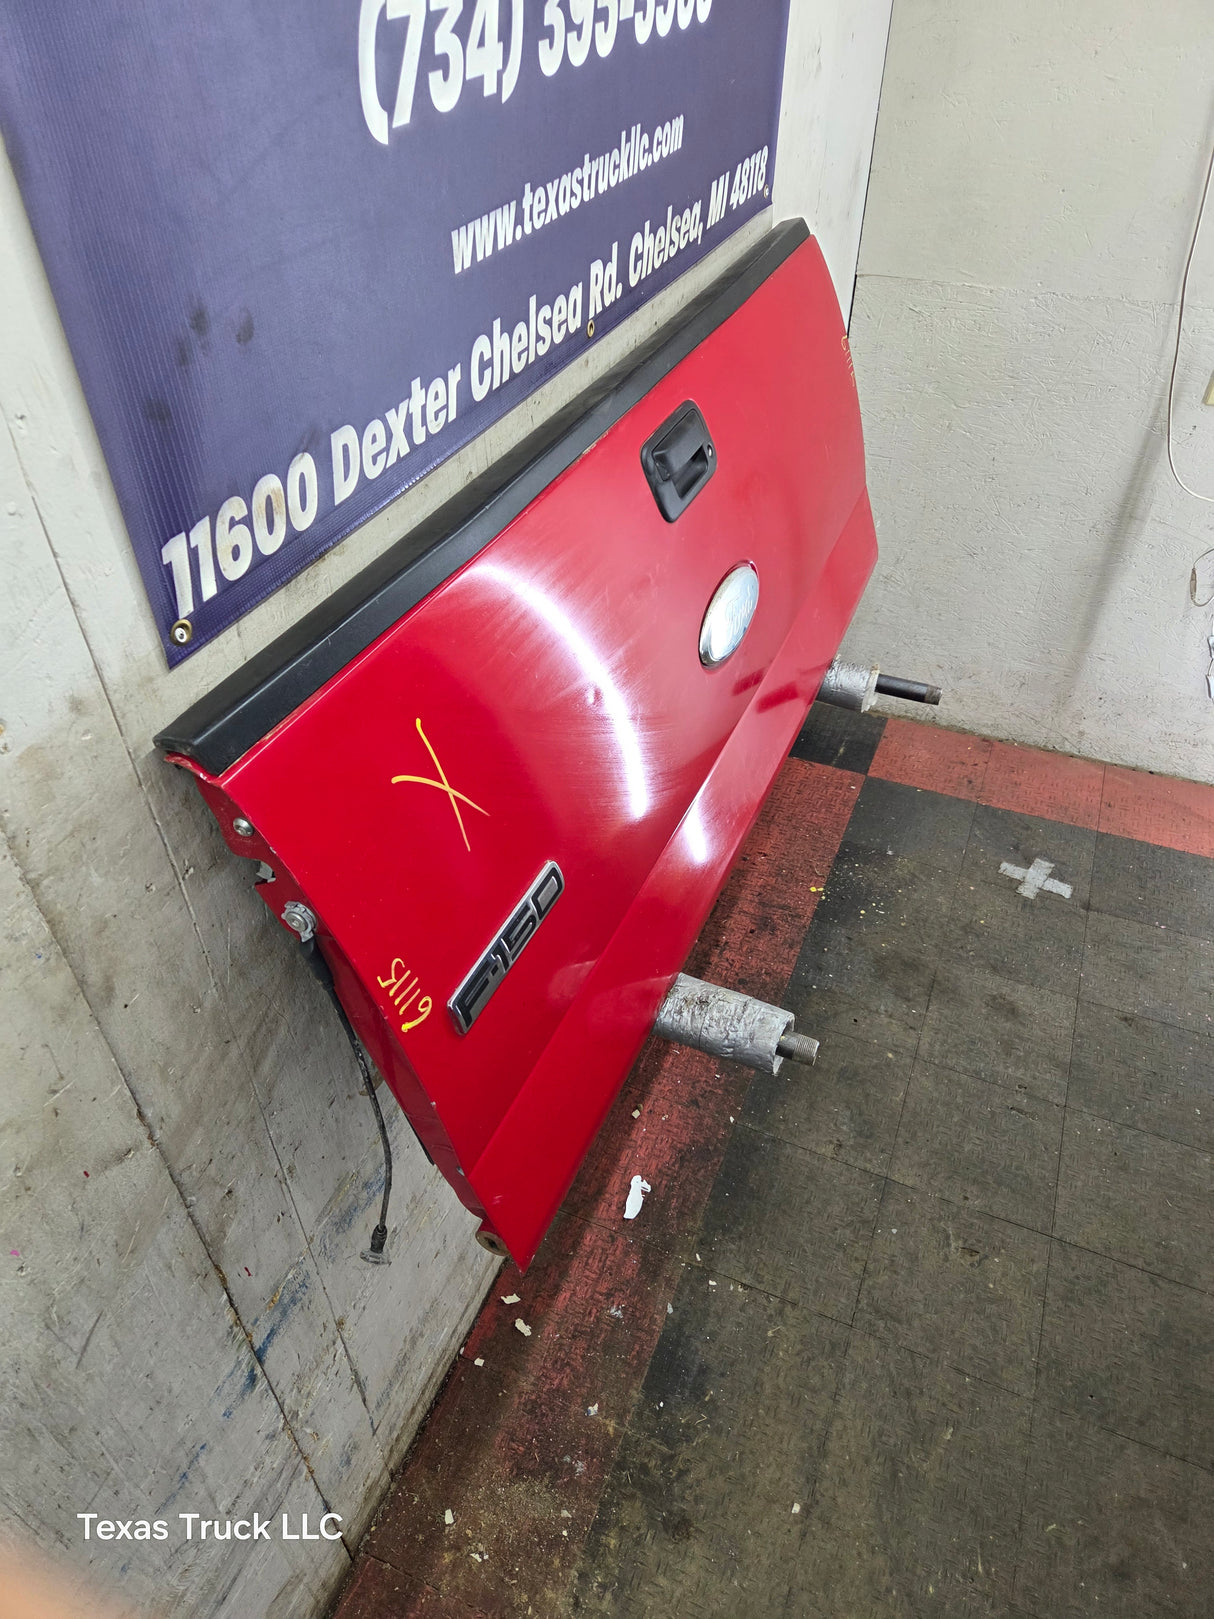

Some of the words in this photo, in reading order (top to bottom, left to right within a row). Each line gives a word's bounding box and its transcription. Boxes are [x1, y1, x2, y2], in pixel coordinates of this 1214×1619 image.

[358, 0, 525, 146] (734)
[450, 114, 685, 274] www.texastruckllc.com
[161, 453, 319, 620] 11600
[330, 363, 462, 507] Dexter
[470, 281, 583, 402] Chelsea
[588, 241, 623, 319] Rd.
[628, 199, 704, 288] Chelsea,
[707, 170, 730, 230] MI
[730, 145, 769, 211] 48118
[449, 865, 564, 1031] F-150
